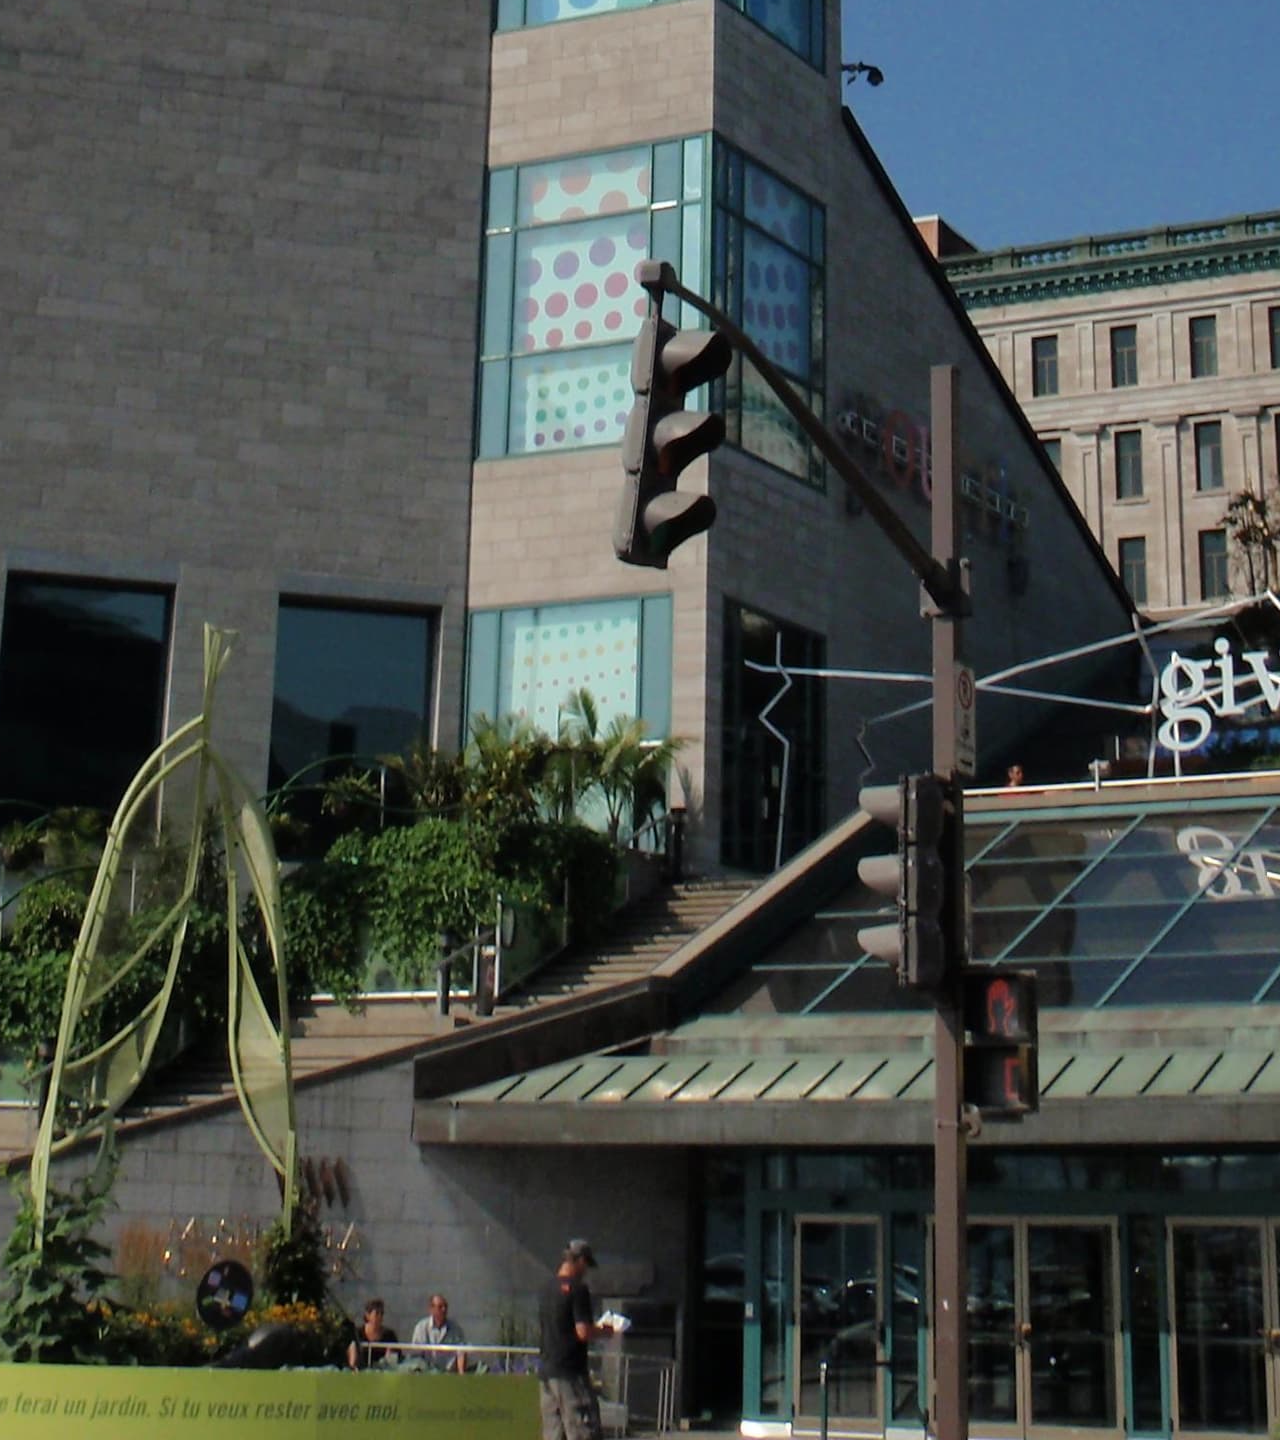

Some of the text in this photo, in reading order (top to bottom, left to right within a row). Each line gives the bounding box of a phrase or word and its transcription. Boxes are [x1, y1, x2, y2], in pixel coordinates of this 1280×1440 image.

[63, 1398, 87, 1416] un
[90, 1394, 151, 1420] jardin.
[158, 1396, 176, 1418] Si
[183, 1399, 200, 1419] tu
[208, 1402, 248, 1419] veux
[256, 1400, 313, 1420] rester
[317, 1403, 361, 1422] avec
